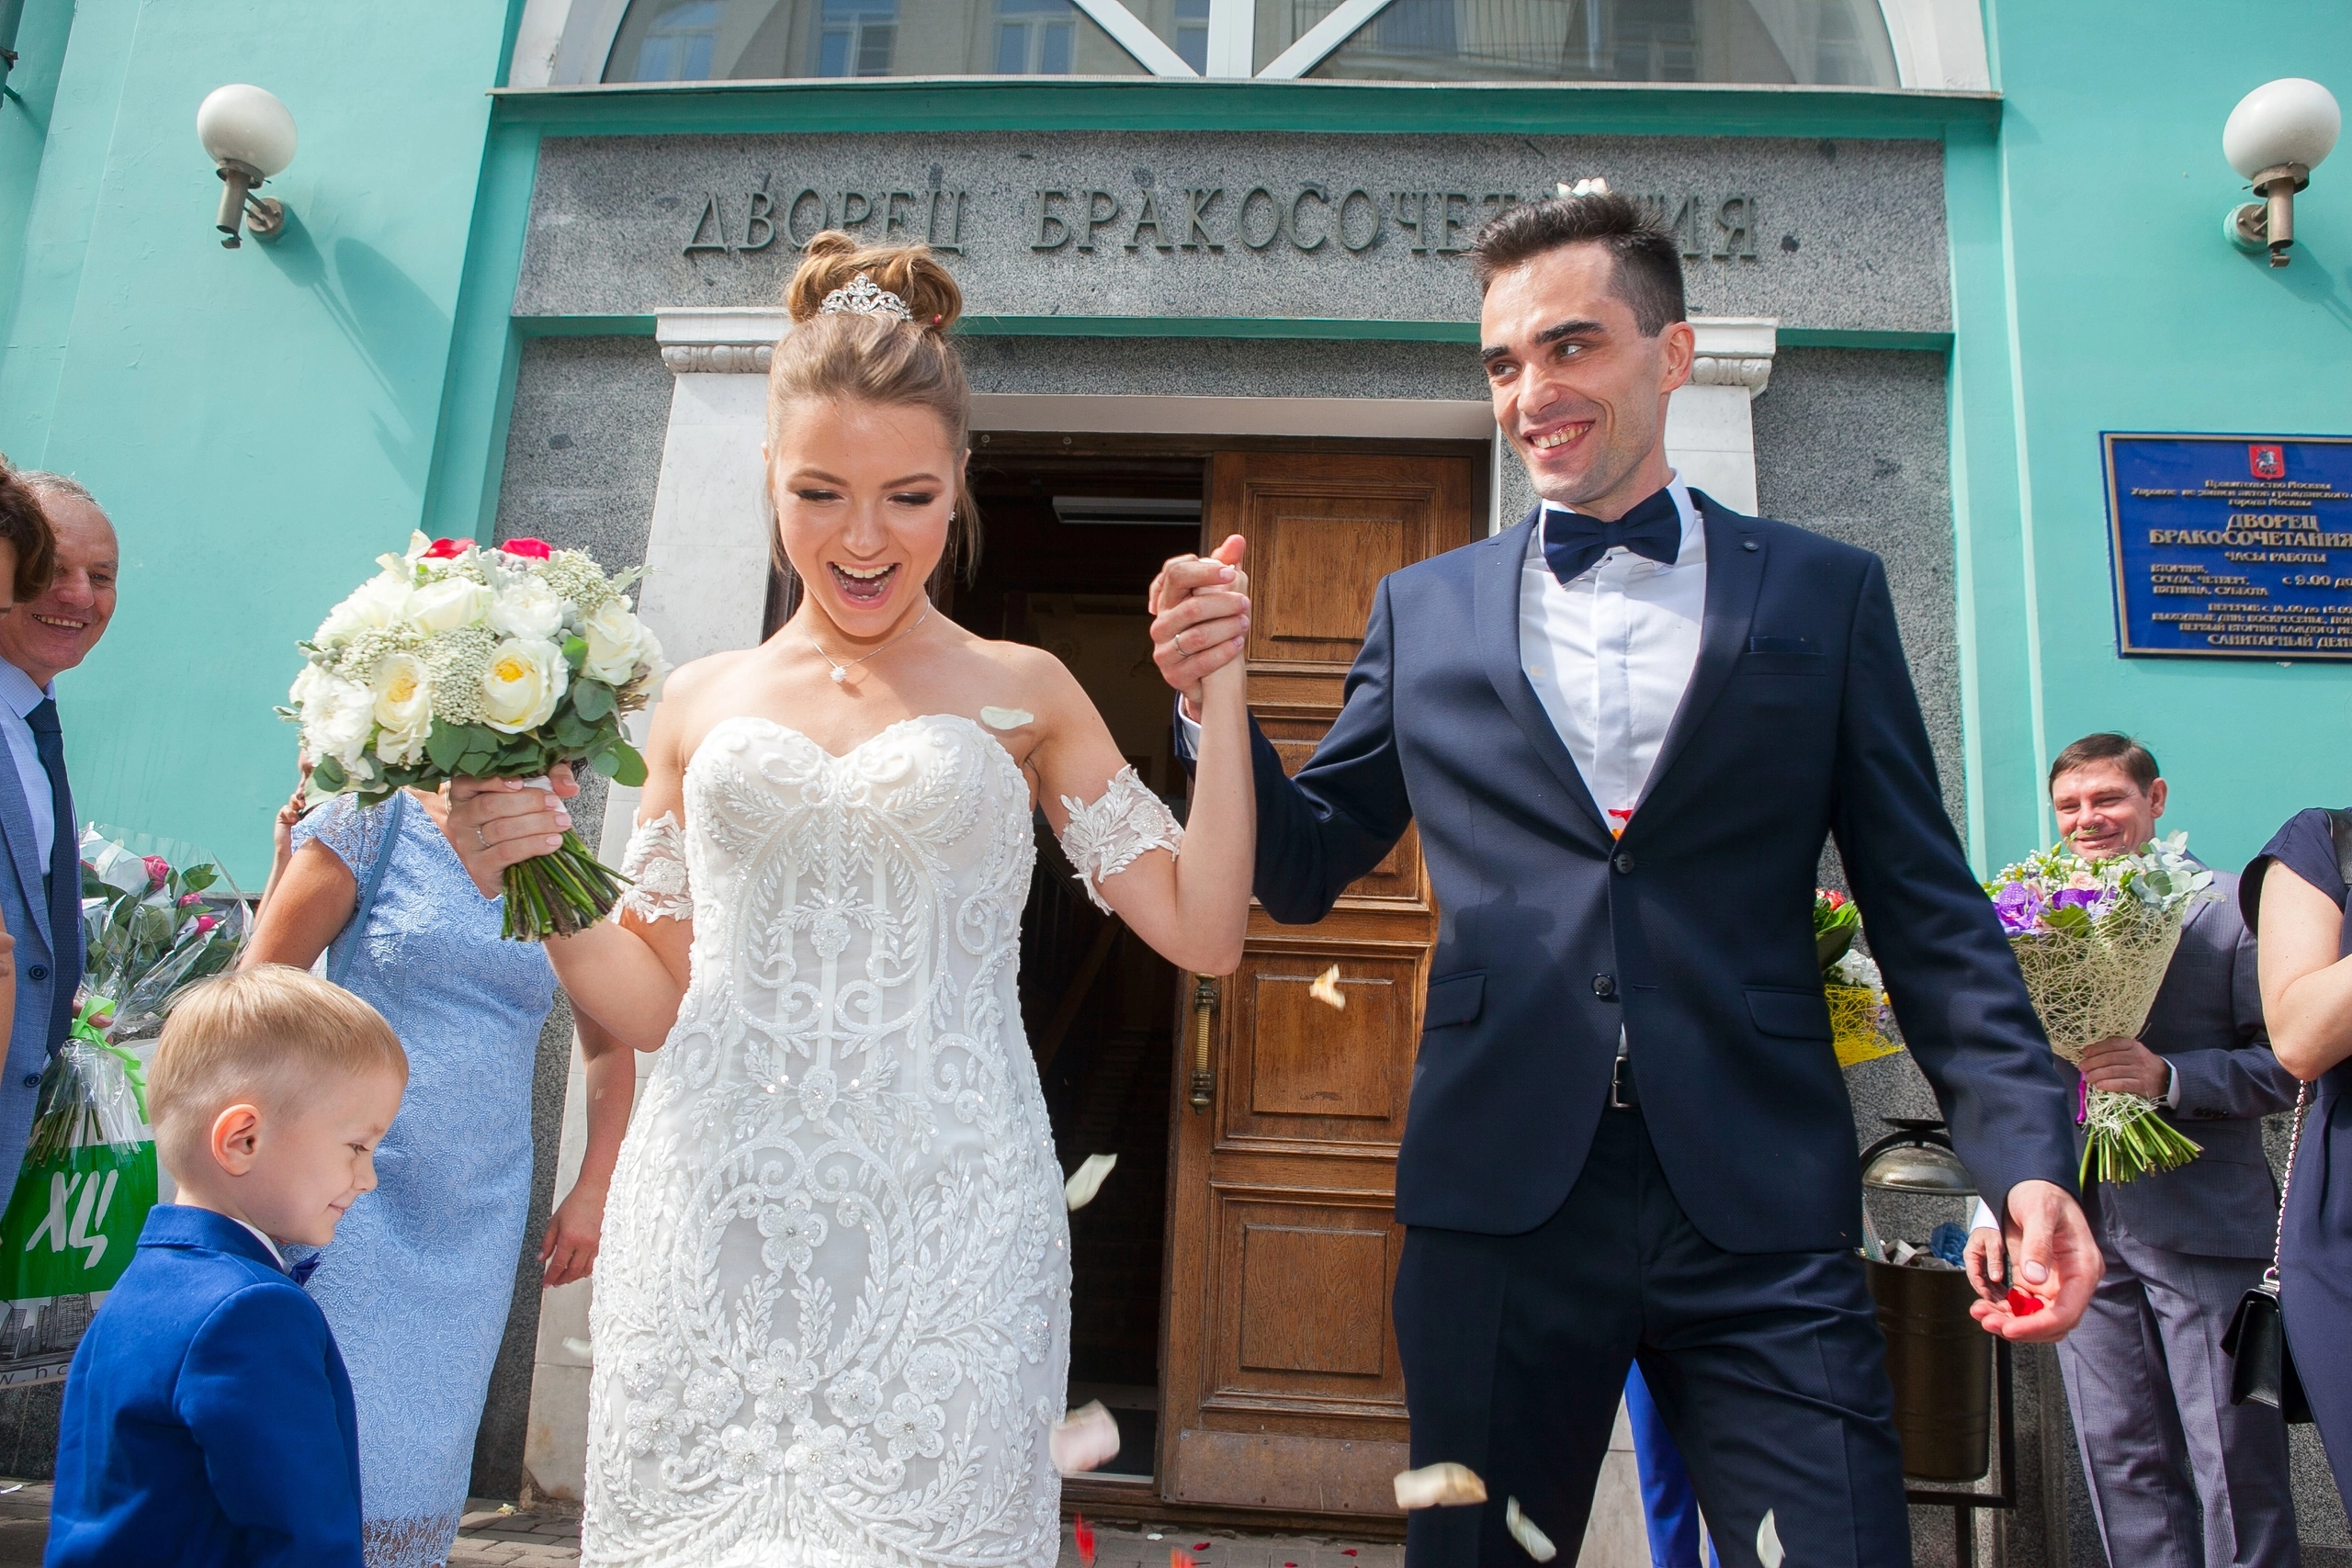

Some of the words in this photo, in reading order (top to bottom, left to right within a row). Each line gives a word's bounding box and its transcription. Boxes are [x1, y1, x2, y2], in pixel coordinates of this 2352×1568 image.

[682, 188, 966, 255] ДВОРЕЦ
[1030, 186, 1758, 259] БРАКОСОЧЕИЯ
[2226, 514, 2320, 532] ДВОРЕЦ
[2149, 529, 2352, 547] БРАКОСОЧЕТАНИЯ
[2225, 552, 2266, 560] ЧАСЫ
[2270, 553, 2325, 562] РАБОТЫ
[2281, 577, 2292, 585] с
[2295, 575, 2331, 585] 9.00
[2335, 579, 2352, 587] до
[2208, 634, 2313, 647] САНИТАРНЫЙ
